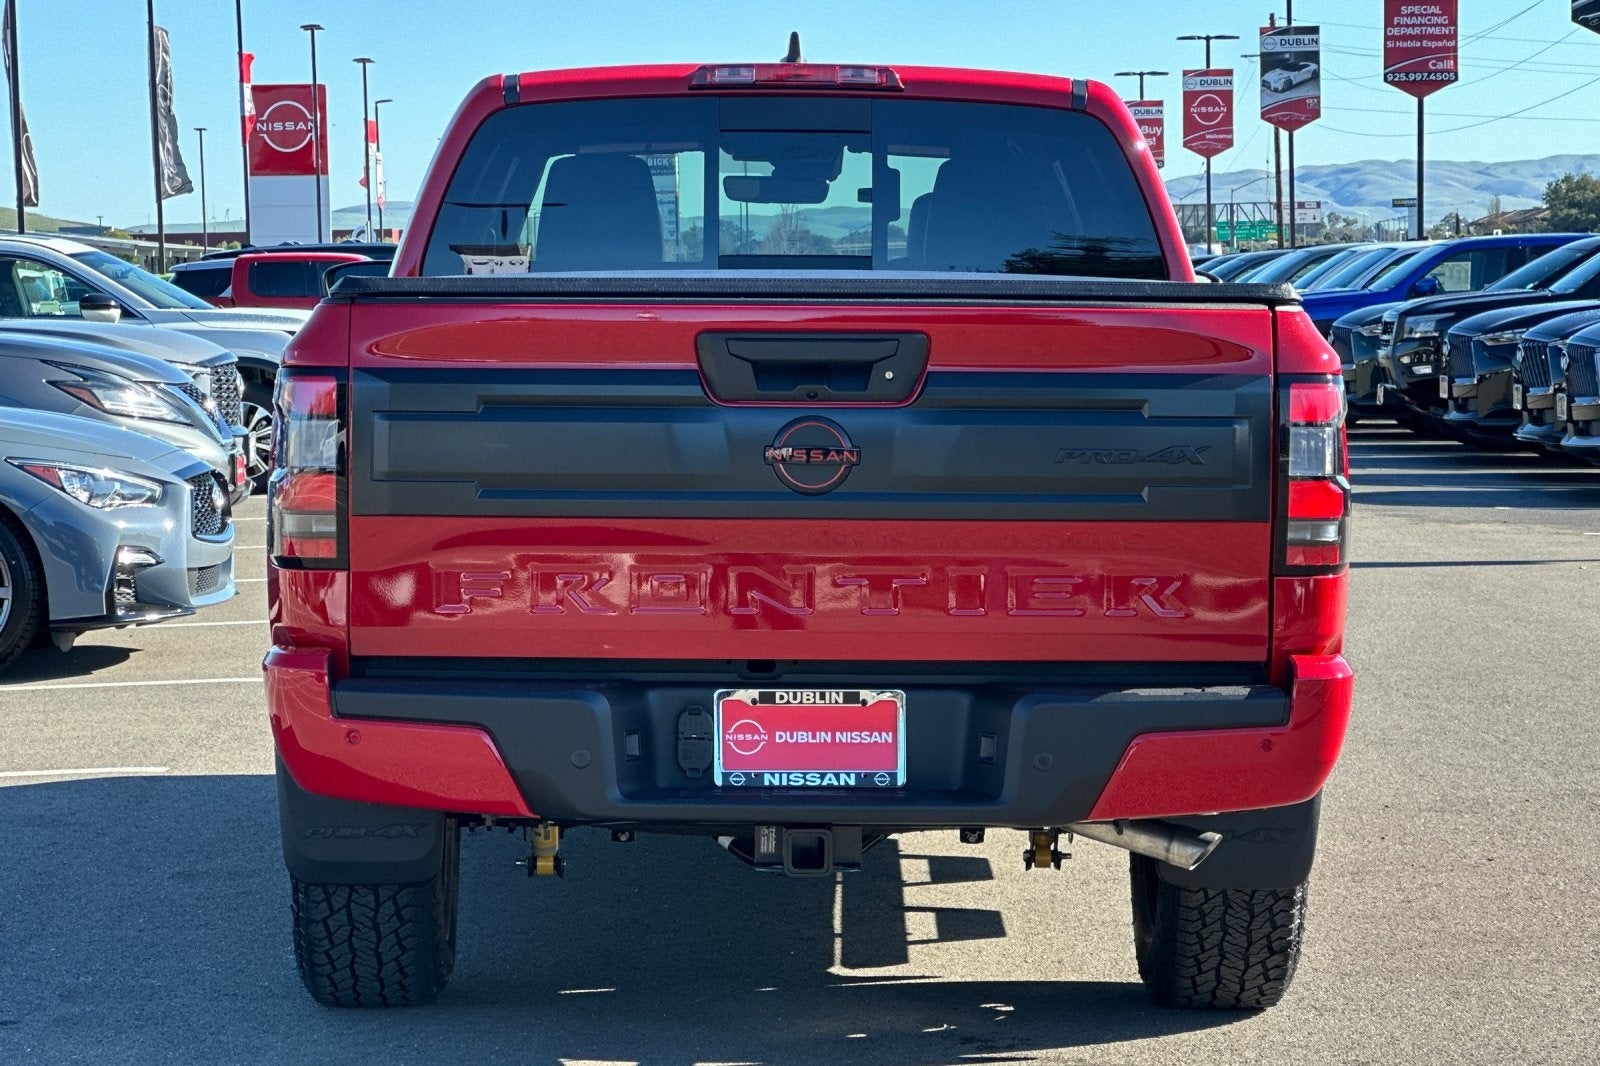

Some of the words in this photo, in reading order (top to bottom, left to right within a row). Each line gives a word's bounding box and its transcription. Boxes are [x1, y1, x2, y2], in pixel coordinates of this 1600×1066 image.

[1401, 6, 1442, 14] SPECIAL
[1393, 16, 1448, 25] FINANCING
[1386, 26, 1456, 35] DEPARTMENT
[1280, 37, 1318, 46] DUBLIN
[1422, 39, 1455, 48] Español
[1428, 60, 1454, 70] Call!
[1386, 72, 1456, 81] 925.997.4505
[1200, 78, 1233, 86] DUBLIN
[256, 121, 315, 132] NISSAN
[1140, 125, 1163, 137] Buy
[766, 448, 859, 464] NISSAN
[1055, 445, 1212, 466] PRO-4X
[433, 562, 1194, 618] FRONTIER
[775, 691, 844, 705] DUBLIN
[725, 733, 768, 741] NISSAN
[775, 731, 832, 744] DUBLIN
[835, 731, 893, 744] NISSAN
[763, 772, 856, 786] NISSAN
